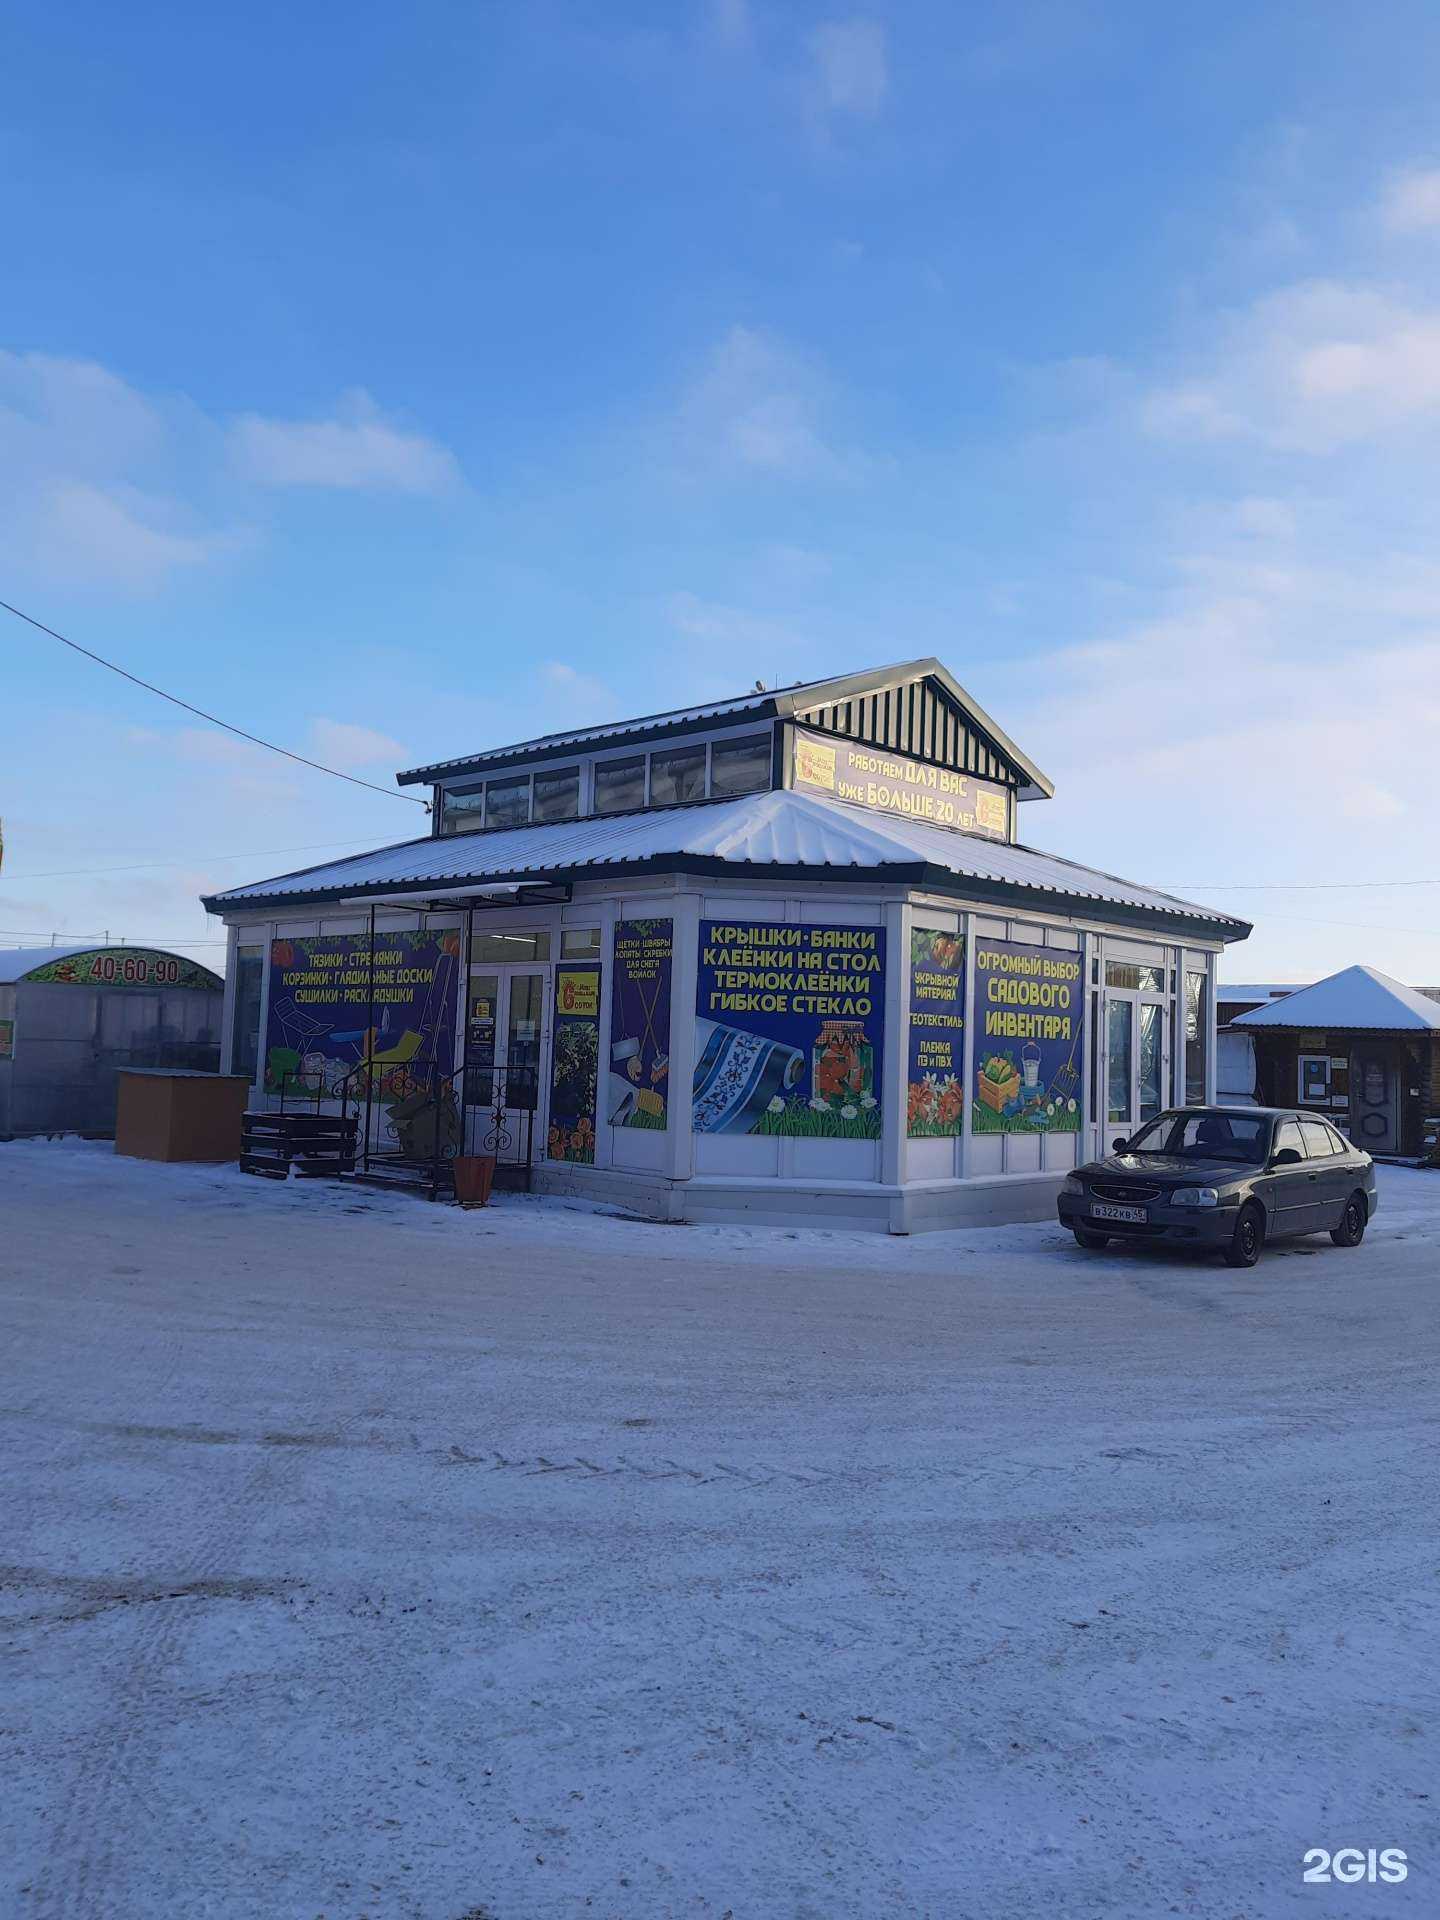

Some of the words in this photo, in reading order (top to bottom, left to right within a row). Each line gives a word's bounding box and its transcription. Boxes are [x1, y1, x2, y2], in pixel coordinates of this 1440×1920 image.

[848, 752, 903, 780] РАБОТАЕМ
[904, 761, 937, 789] ДЛЯ
[939, 773, 968, 797] ВАС
[838, 781, 864, 802] УЖЕ
[867, 783, 934, 818] БОЛЬШЕ
[935, 799, 954, 823] 20
[710, 926, 801, 946] КРЫШКИ
[810, 930, 876, 950] БАНКИ
[90, 957, 178, 983] 40-60-90
[308, 952, 344, 968] ТАЗИКИ
[349, 951, 403, 966] СТРЕМЯНКИ
[703, 945, 793, 968] КЛЕЁНКИ
[797, 952, 822, 970] НА
[826, 953, 881, 972] СТОЛ
[977, 951, 1042, 977] ОГРОМНЫЙ
[1043, 960, 1080, 982] ВЫБОР
[282, 971, 329, 986] КОРЗИНКИ
[396, 967, 434, 984] ДОСКИ
[714, 970, 871, 993] ТЕРМОКЛЕЁНКИ
[914, 972, 960, 988] УКРЫВНОЙ
[294, 989, 339, 1003] СУШИЛКИ
[709, 992, 788, 1012] ГИБКОЕ
[791, 995, 872, 1016] СТЕКЛО
[915, 986, 957, 1001] МАТЕРИАЛ
[987, 977, 1070, 1009] САДОВОГО
[908, 1012, 964, 1028] ГЕОТЕКСТИЛЬ
[985, 1011, 1071, 1040] ИНВЕНТАРЯ
[936, 1055, 953, 1068] ПВХ
